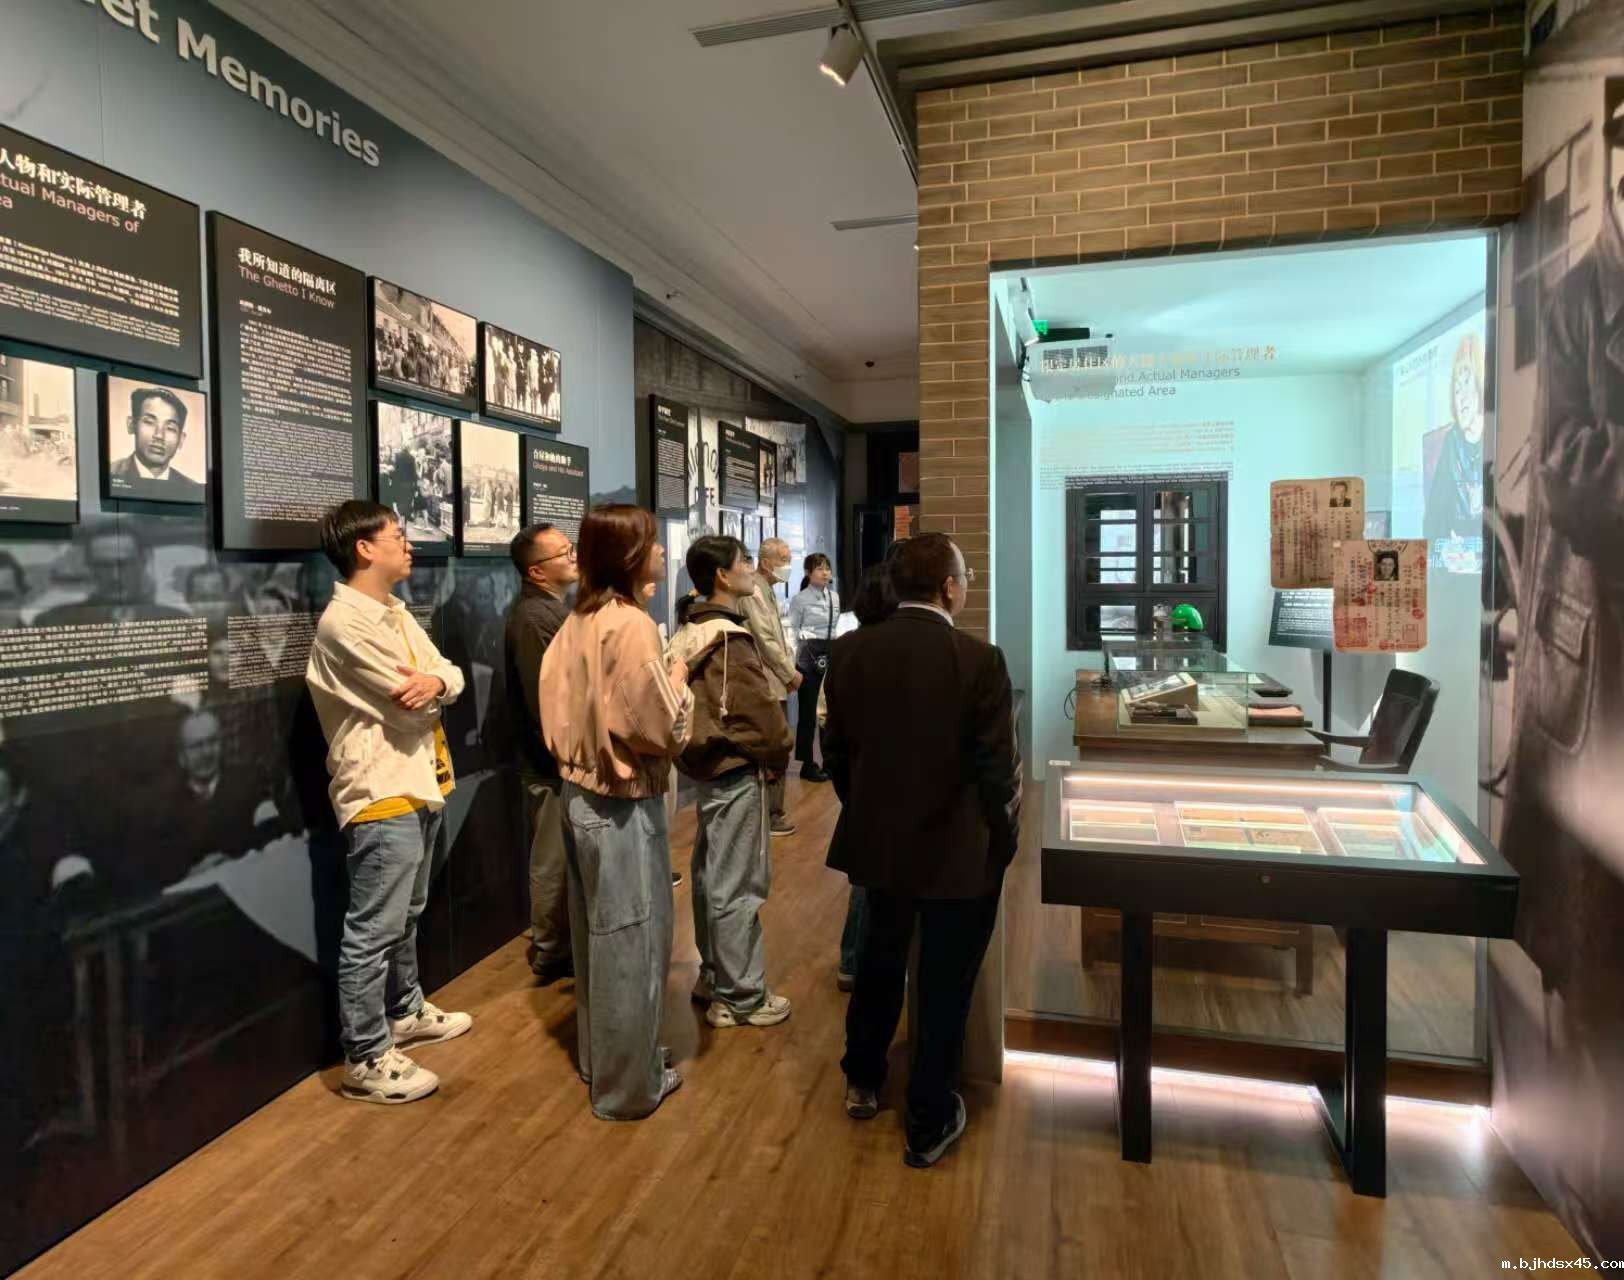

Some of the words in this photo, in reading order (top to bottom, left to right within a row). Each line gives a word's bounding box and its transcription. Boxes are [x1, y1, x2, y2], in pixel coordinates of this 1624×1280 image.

[177, 17, 381, 168] Memories
[0, 172, 35, 197] tual
[42, 187, 121, 229] Managers
[124, 220, 141, 234] of
[238, 246, 337, 296] 我所知道的隔离区
[239, 265, 261, 283] The
[263, 274, 299, 297] Ghetto
[301, 288, 307, 300] I
[309, 292, 335, 309] Know
[1138, 367, 1176, 382] Actual
[1180, 365, 1241, 382] Managers
[1148, 385, 1176, 397] Area
